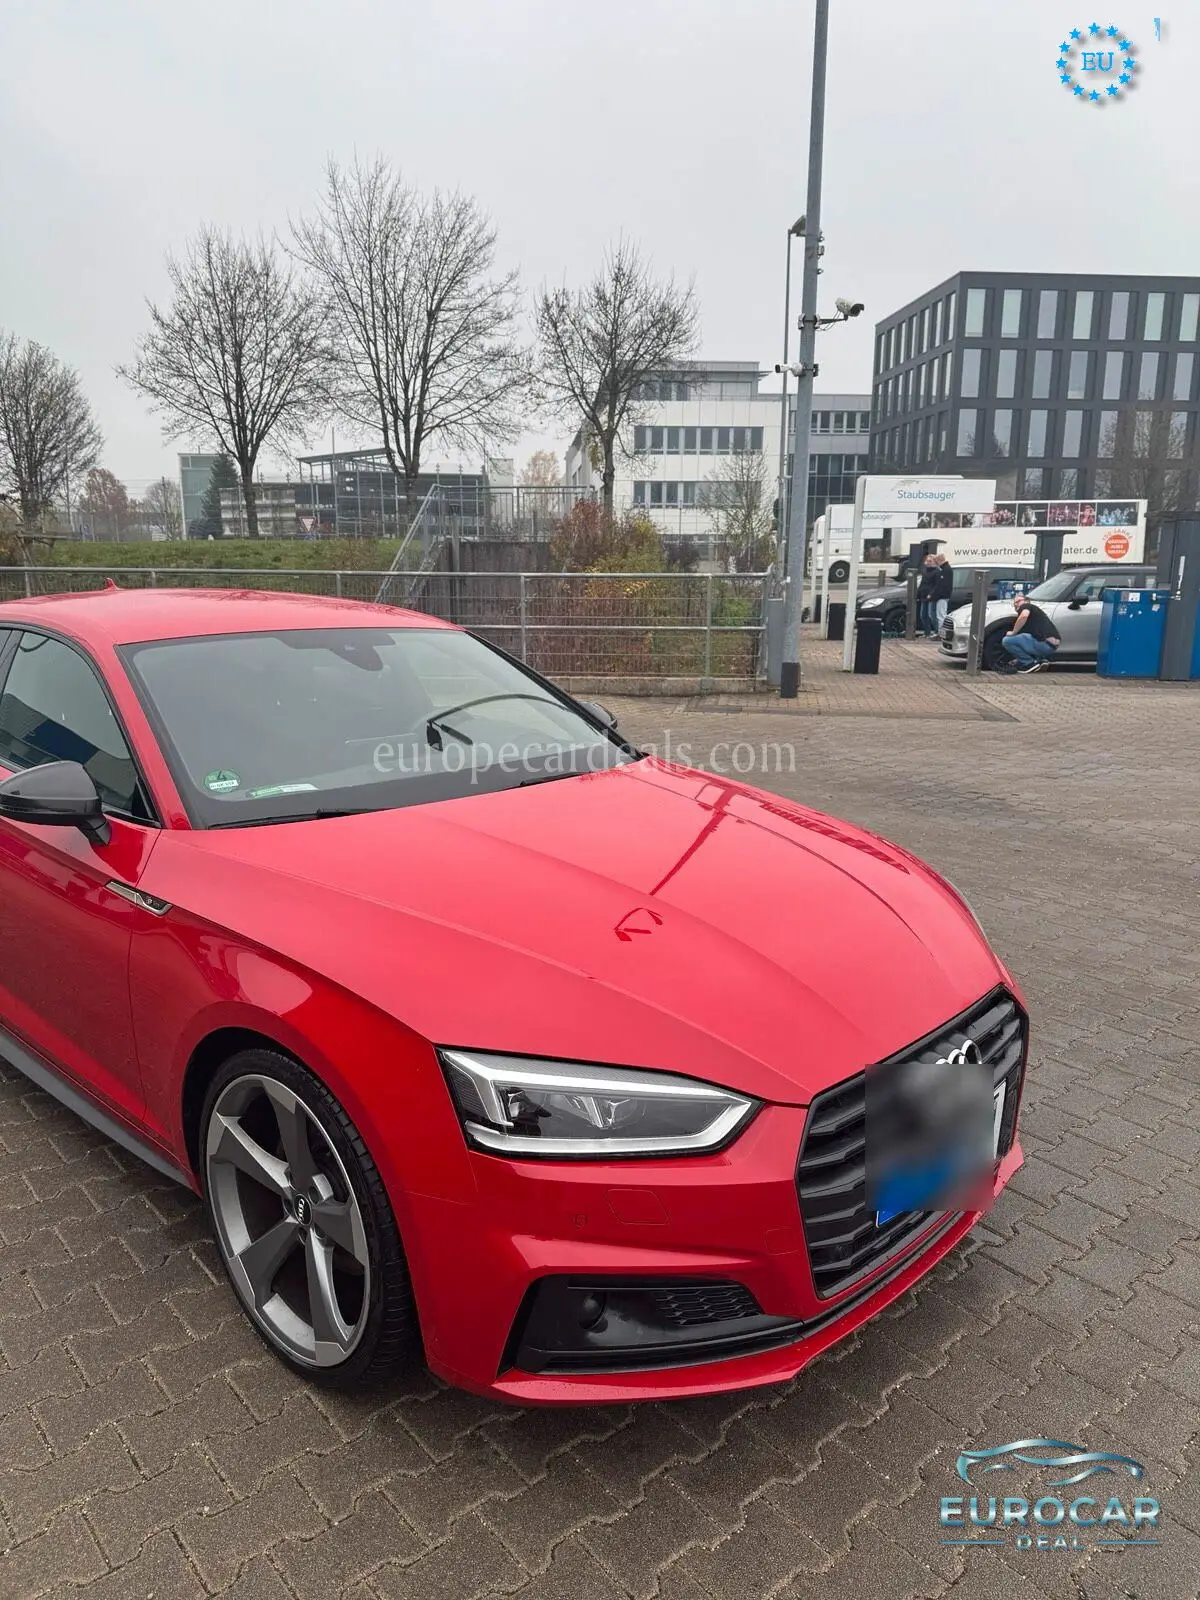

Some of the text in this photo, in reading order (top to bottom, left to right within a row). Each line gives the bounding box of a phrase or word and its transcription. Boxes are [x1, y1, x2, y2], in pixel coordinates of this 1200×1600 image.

[897, 489, 956, 502] Staubsauger
[863, 513, 893, 522] ubsauger
[954, 545, 1098, 557] www.gaertnerplaater.de
